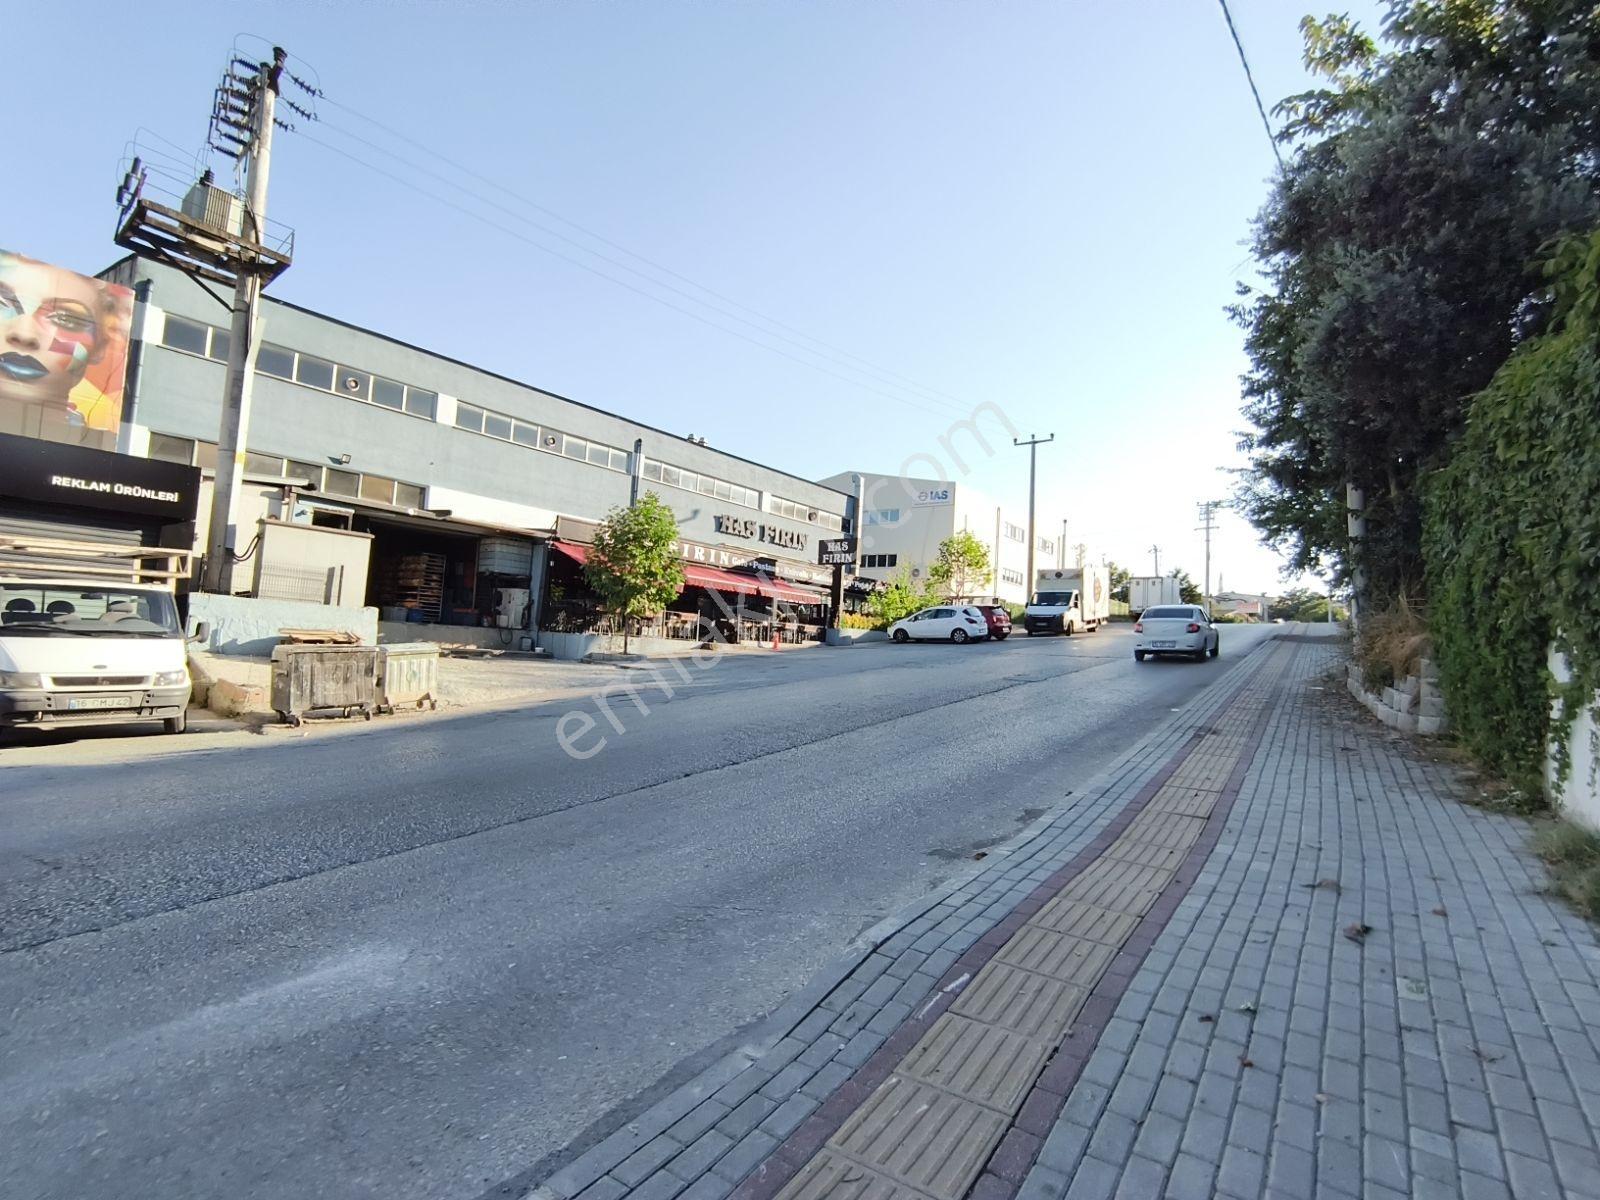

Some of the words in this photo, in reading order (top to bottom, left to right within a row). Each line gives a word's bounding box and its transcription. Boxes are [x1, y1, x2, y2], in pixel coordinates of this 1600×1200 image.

[52, 475, 110, 493] REKLAM
[114, 483, 178, 502] ÜRÜNLERİ
[721, 514, 757, 538] HAS
[763, 523, 810, 550] FIRIN
[827, 541, 849, 552] HAS
[822, 552, 853, 564] FIRIN
